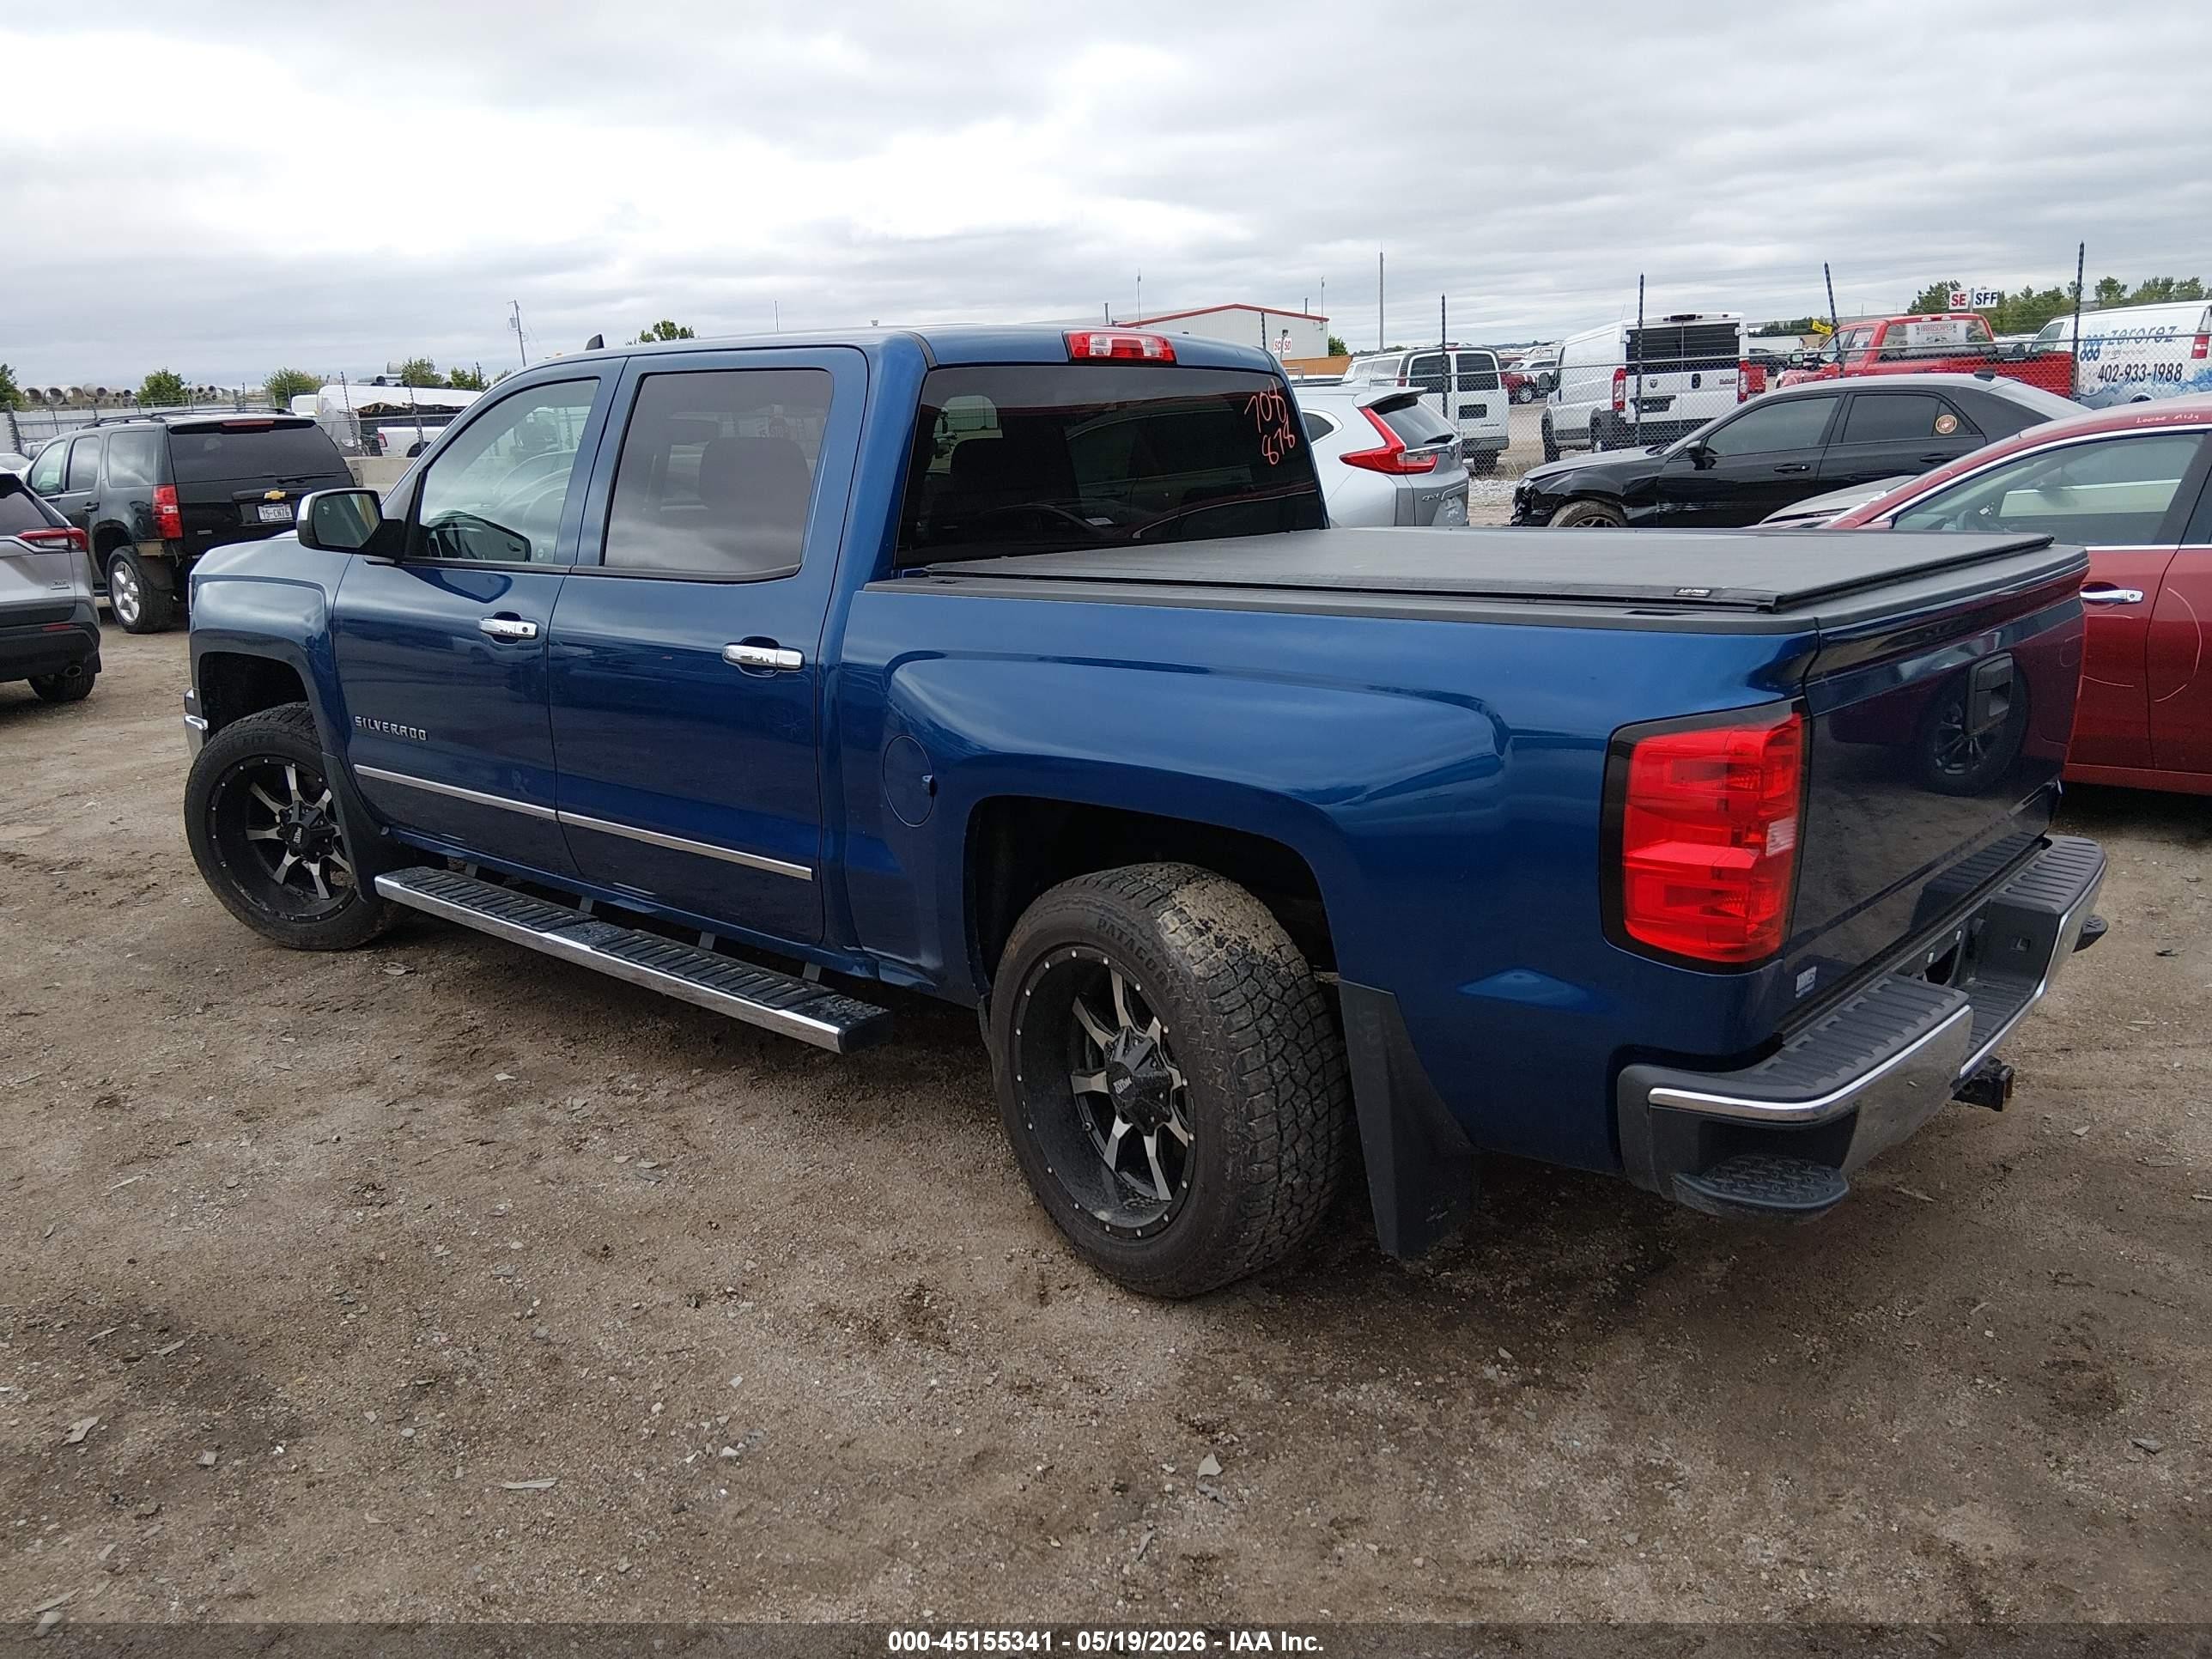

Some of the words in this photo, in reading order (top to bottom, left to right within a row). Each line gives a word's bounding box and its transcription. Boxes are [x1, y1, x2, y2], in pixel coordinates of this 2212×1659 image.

[1951, 293, 1967, 307] SE
[1975, 292, 1997, 306] SFF
[2097, 362, 2184, 383] 402-933-1988
[355, 715, 428, 741] SILVERADO
